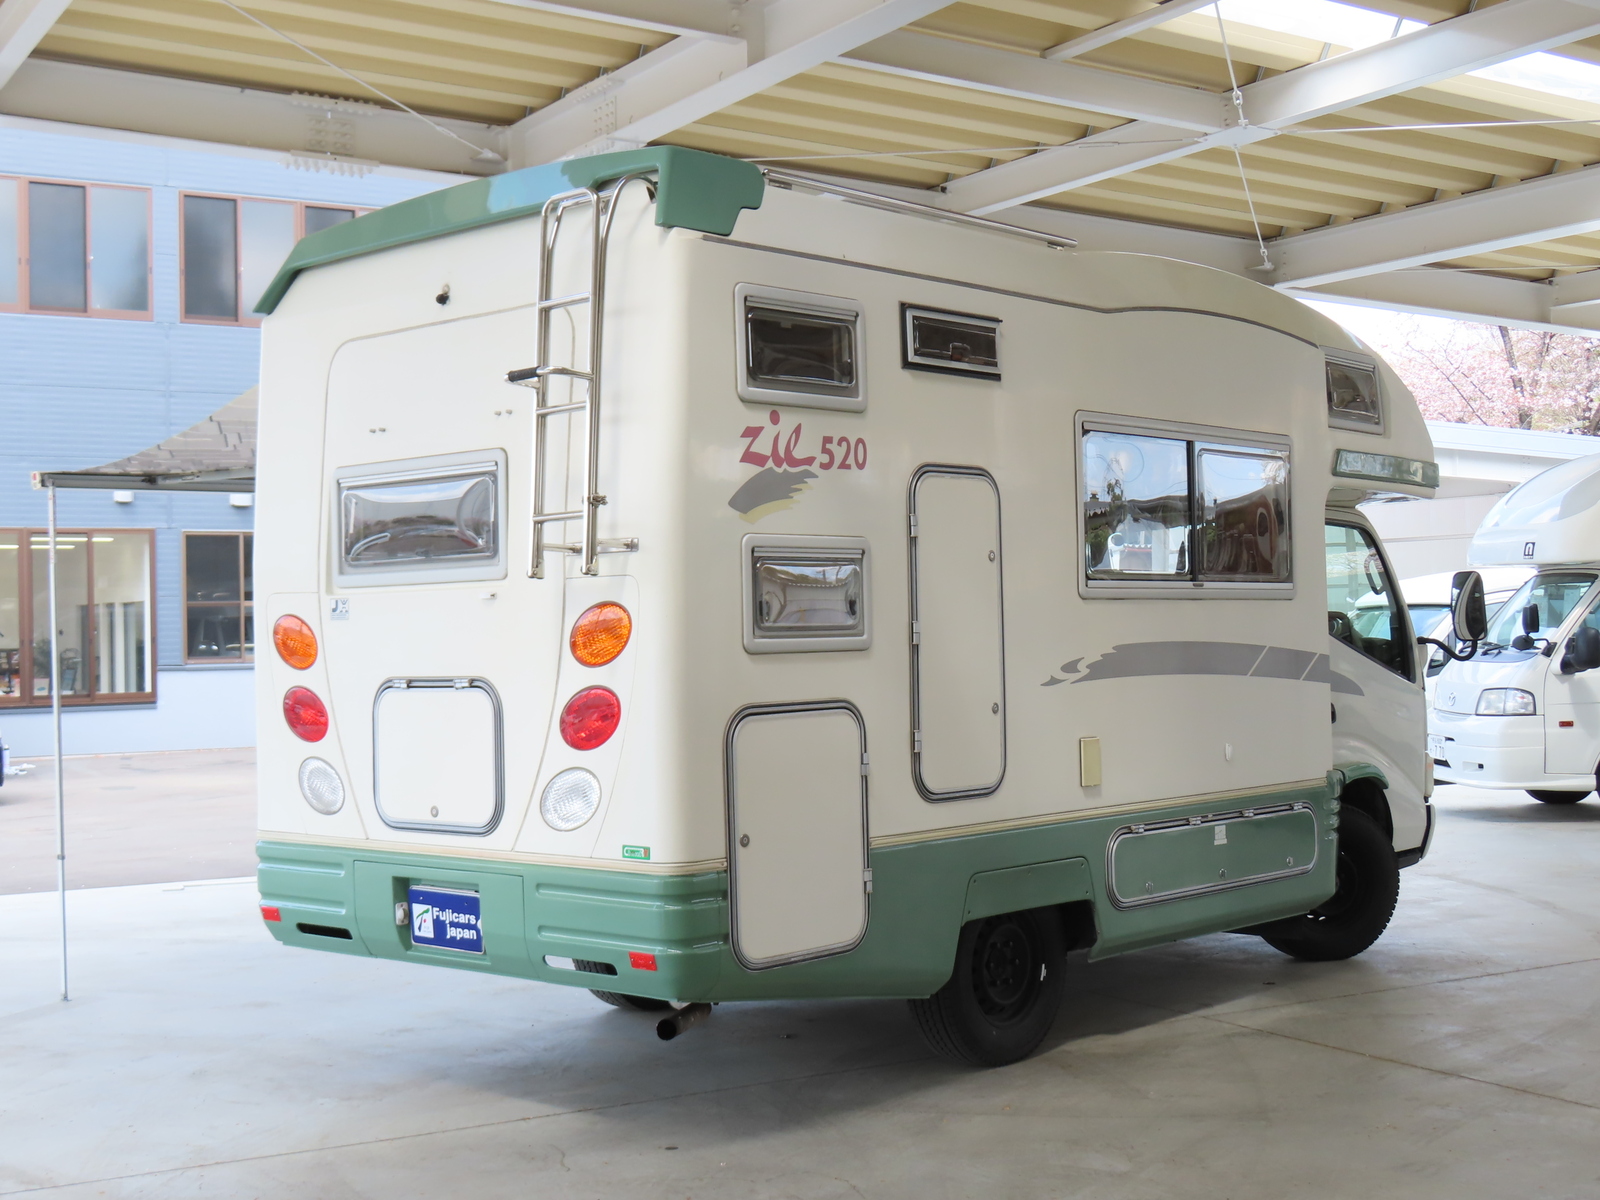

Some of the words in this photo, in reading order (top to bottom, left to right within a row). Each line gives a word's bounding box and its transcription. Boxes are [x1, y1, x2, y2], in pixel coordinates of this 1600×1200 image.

[739, 409, 817, 468] zil
[819, 435, 868, 470] 520
[433, 906, 477, 925] Fujicars
[446, 924, 477, 940] japan
